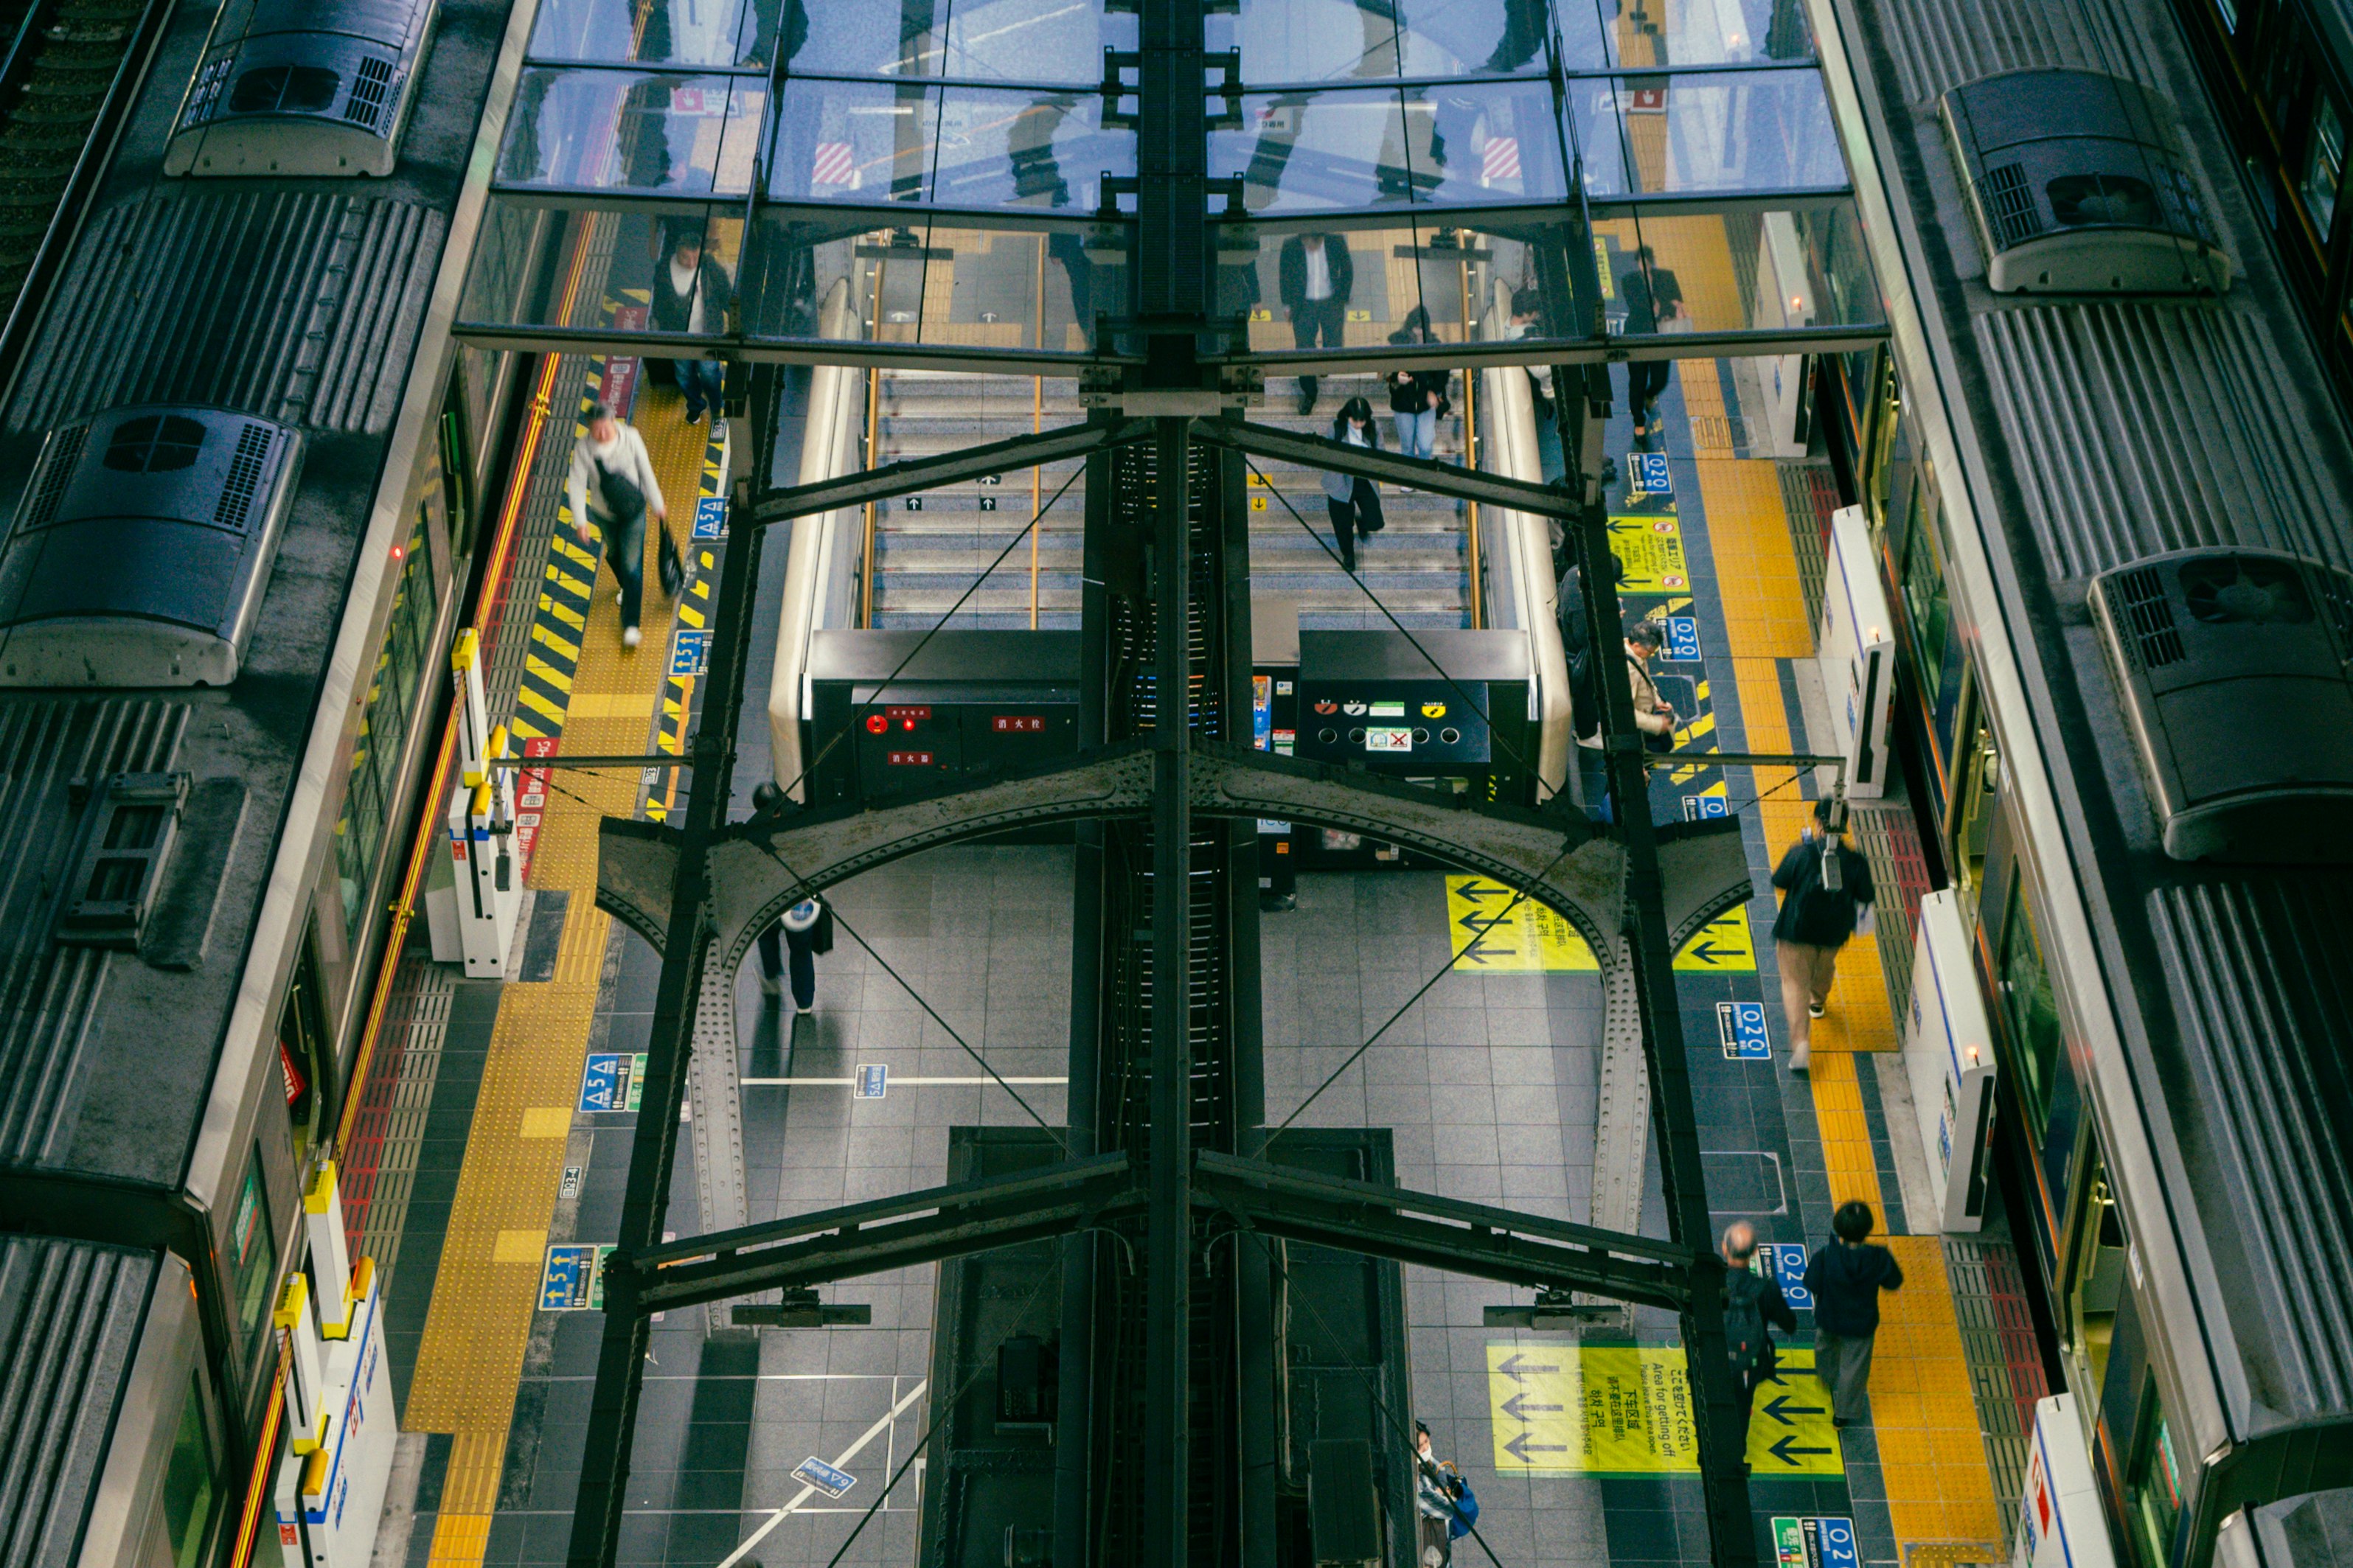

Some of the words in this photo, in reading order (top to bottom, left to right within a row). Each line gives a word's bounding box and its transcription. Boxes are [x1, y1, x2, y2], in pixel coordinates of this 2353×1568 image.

[588, 1079, 605, 1087] 5
[549, 1272, 567, 1282] 5
[1641, 1364, 1649, 1385] Please
[1652, 1362, 1664, 1385] Area
[1589, 1390, 1604, 1407] 하차
[1656, 1387, 1668, 1402] for
[1623, 1389, 1641, 1430] 下车区域
[1644, 1406, 1653, 1418] this
[1670, 1369, 1691, 1452] ここを空けてください
[1591, 1410, 1605, 1428] 구역
[1655, 1404, 1672, 1440] getting
[1662, 1443, 1675, 1457] off
